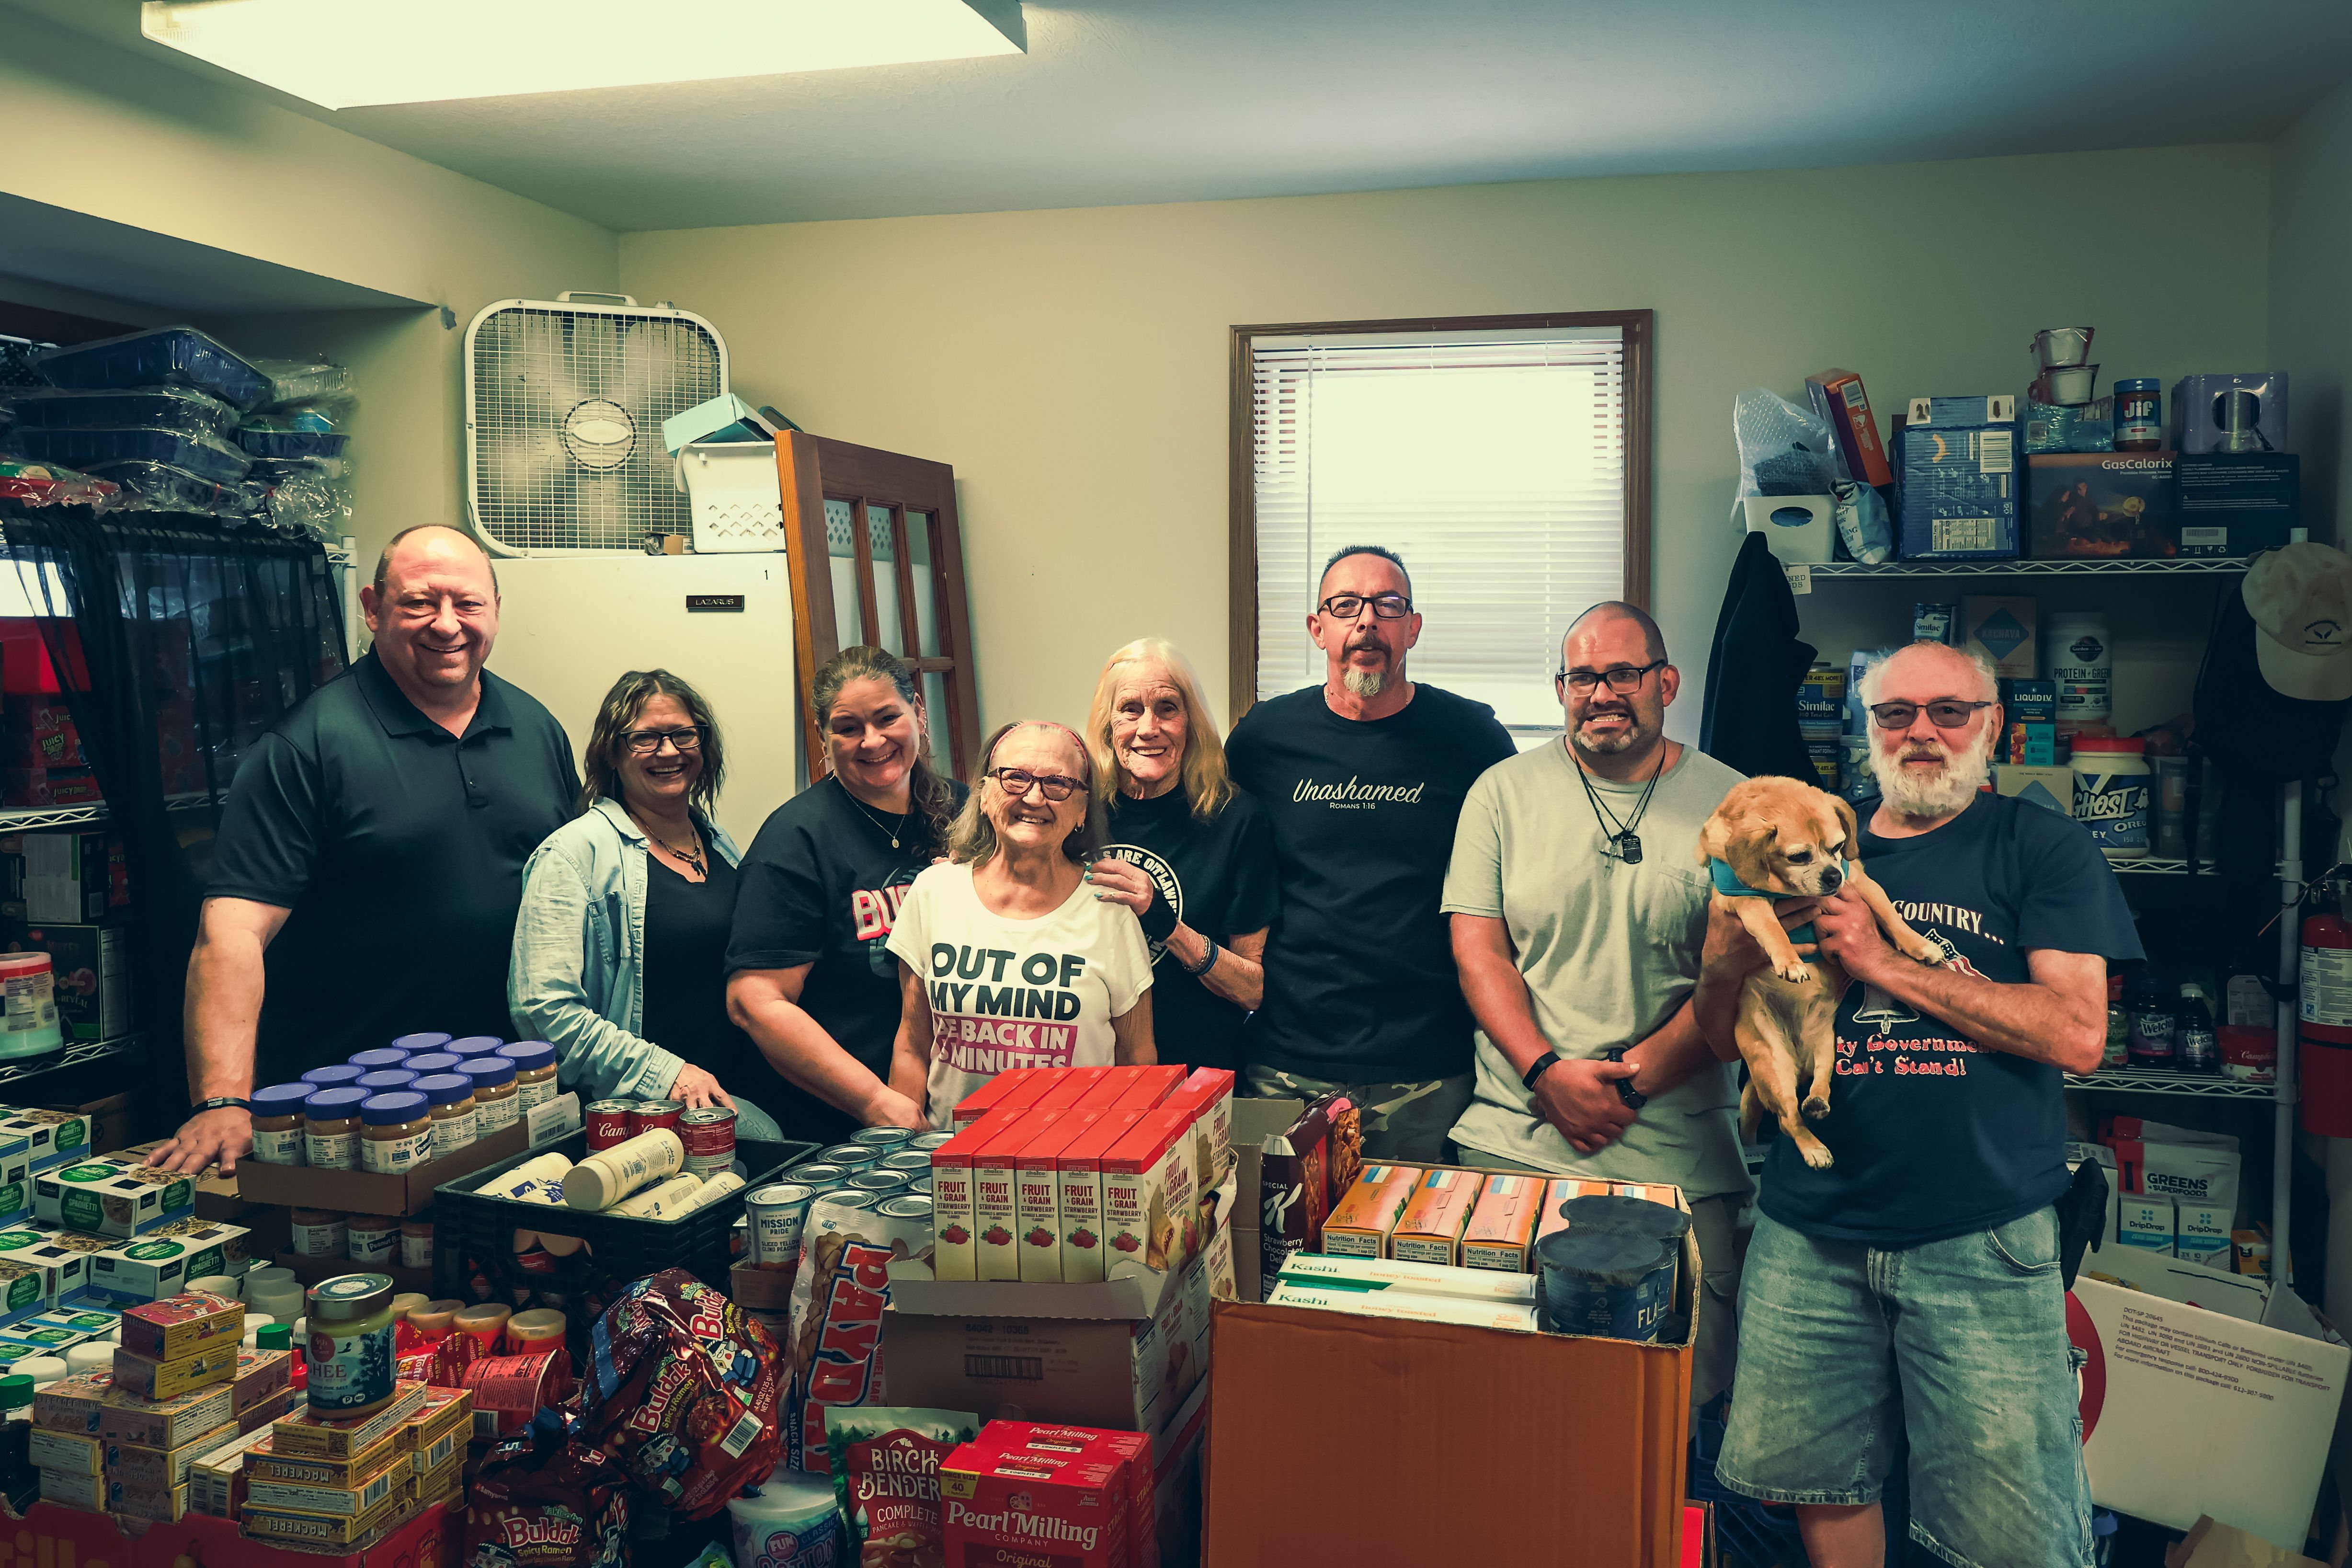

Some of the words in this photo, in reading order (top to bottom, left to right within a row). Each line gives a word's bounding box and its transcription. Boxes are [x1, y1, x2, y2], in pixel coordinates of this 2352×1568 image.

[2124, 400, 2154, 418] Jif
[2101, 458, 2173, 470] GasCalorix
[765, 569, 768, 580] 1
[1916, 622, 1940, 632] Similac
[2054, 668, 2086, 678] PROTEIN
[2014, 694, 2043, 702] LIQUID
[1798, 699, 1835, 712] Similac
[42, 733, 65, 751] JUICY
[53, 786, 74, 798] JUICY
[1293, 775, 1425, 804] Unashamed
[1115, 849, 1143, 865] ARE
[851, 884, 911, 941] BU
[931, 942, 1016, 982] OUT
[1021, 952, 1086, 988] OF
[930, 980, 972, 1015] MY
[976, 984, 1081, 1020] MIND
[964, 1020, 1038, 1049] BACK
[1039, 1026, 1069, 1050] IN
[951, 1043, 1073, 1073] MINUTES
[1836, 1055, 1884, 1076] Can't
[1894, 1054, 1967, 1077] Stand!
[1165, 1155, 1181, 1185] FRUIT
[937, 1180, 967, 1193] FRUIT
[980, 1181, 1008, 1194] FRUIT
[1169, 1166, 1188, 1196] GRAIN
[1262, 1180, 1288, 1190] SPECIAL
[2147, 1172, 2208, 1190] GREENS
[1021, 1183, 1051, 1196] FRUIT
[1064, 1184, 1094, 1197] FRUIT
[1107, 1187, 1138, 1200] FRUIT
[2153, 1184, 2207, 1197] SUPERFOODS
[944, 1193, 967, 1202] GRAIN
[986, 1194, 1009, 1203] GRAIN
[1028, 1196, 1051, 1205] GRAIN
[1071, 1197, 1094, 1206] GRAIN
[1165, 1181, 1193, 1213] STRAWBERRY
[1114, 1200, 1138, 1209] GRAIN
[1107, 1209, 1142, 1217] STRAWBERRY
[760, 1216, 799, 1228] MISSION
[2129, 1221, 2165, 1231] DripDrop
[770, 1227, 789, 1236] PRIDE
[2188, 1225, 2223, 1234] DripDrop
[1264, 1233, 1303, 1247] Strawberry
[1327, 1235, 1355, 1243] Nutrition
[1397, 1241, 1425, 1249] Nutrition
[1467, 1248, 1497, 1257] Nutrition
[191, 1255, 220, 1273] SPAGHETTI
[1269, 1254, 1286, 1265] Deli
[1290, 1263, 1338, 1273] Kashi
[1370, 1271, 1402, 1280] honey
[1403, 1274, 1441, 1283] toasted
[1278, 1293, 1328, 1306] Kashi
[1360, 1305, 1393, 1314] honey
[1393, 1308, 1437, 1317] toasted
[1637, 1303, 1658, 1329] FLA
[2192, 1349, 2227, 1363] TRANSPORT
[2295, 1377, 2331, 1391] TRANSPORT
[630, 1362, 691, 1433] Buldak
[674, 1378, 695, 1404] Ramen
[789, 1411, 799, 1446] SNACK
[1028, 1426, 1060, 1437] Pearl
[1058, 1429, 1099, 1442] Milling
[790, 1448, 801, 1471] SIZE
[870, 1448, 938, 1475] BIRCH
[997, 1452, 1029, 1462] Pearl
[1028, 1454, 1072, 1468] Milling
[269, 1465, 331, 1482] MACKEREL
[950, 1482, 964, 1492] 40
[877, 1504, 938, 1525] COMPLETE
[268, 1520, 328, 1537] MACKEREL
[872, 1520, 900, 1534] PANCAKE
[948, 1500, 1009, 1533] Pearl
[1012, 1511, 1100, 1551] Milling
[503, 1517, 582, 1549] Buldak
[768, 1537, 795, 1553] FUN
[995, 1534, 1049, 1548] COMPANY
[541, 1545, 572, 1556] Ramen
[996, 1549, 1052, 1568] Original
